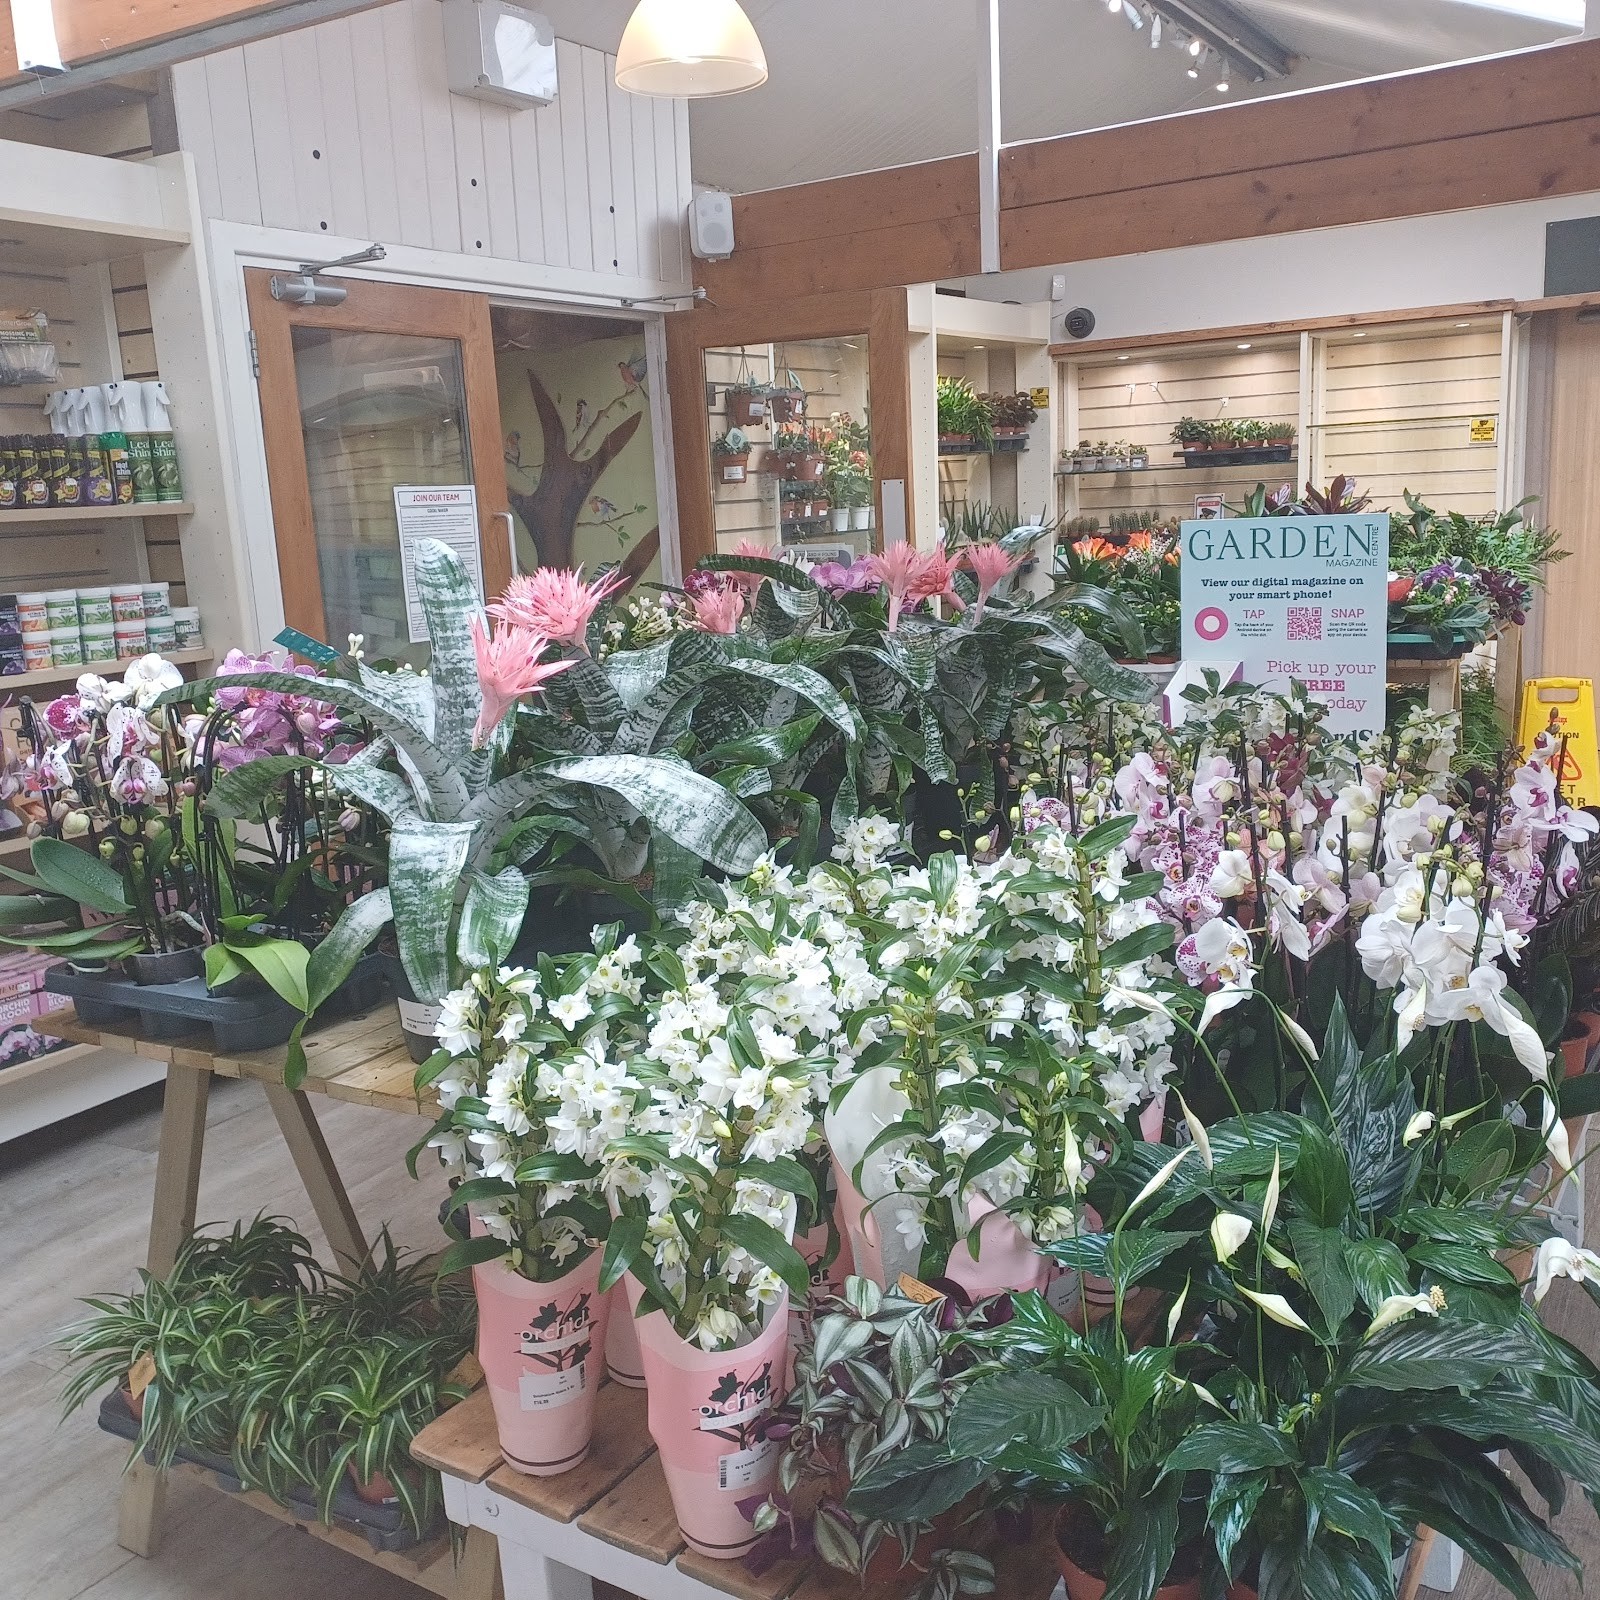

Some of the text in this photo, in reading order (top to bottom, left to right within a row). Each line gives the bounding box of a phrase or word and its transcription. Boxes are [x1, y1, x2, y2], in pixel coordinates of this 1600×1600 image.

[413, 493, 460, 502] JOIN OUR TEAM
[1188, 523, 1374, 561] GARDEN
[1371, 526, 1380, 556] CENTRE
[1325, 558, 1379, 567] MAGAZINE
[1201, 577, 1364, 588] View our digital magazine on
[1229, 589, 1332, 601] your smart phone!
[1243, 609, 1265, 619] TAP
[1331, 608, 1365, 618] SNAP
[1266, 660, 1377, 677] Pick up your
[1327, 696, 1368, 712] oday
[1559, 784, 1576, 794] ET
[520, 1309, 586, 1341] orchid
[698, 1379, 769, 1417] orchid
